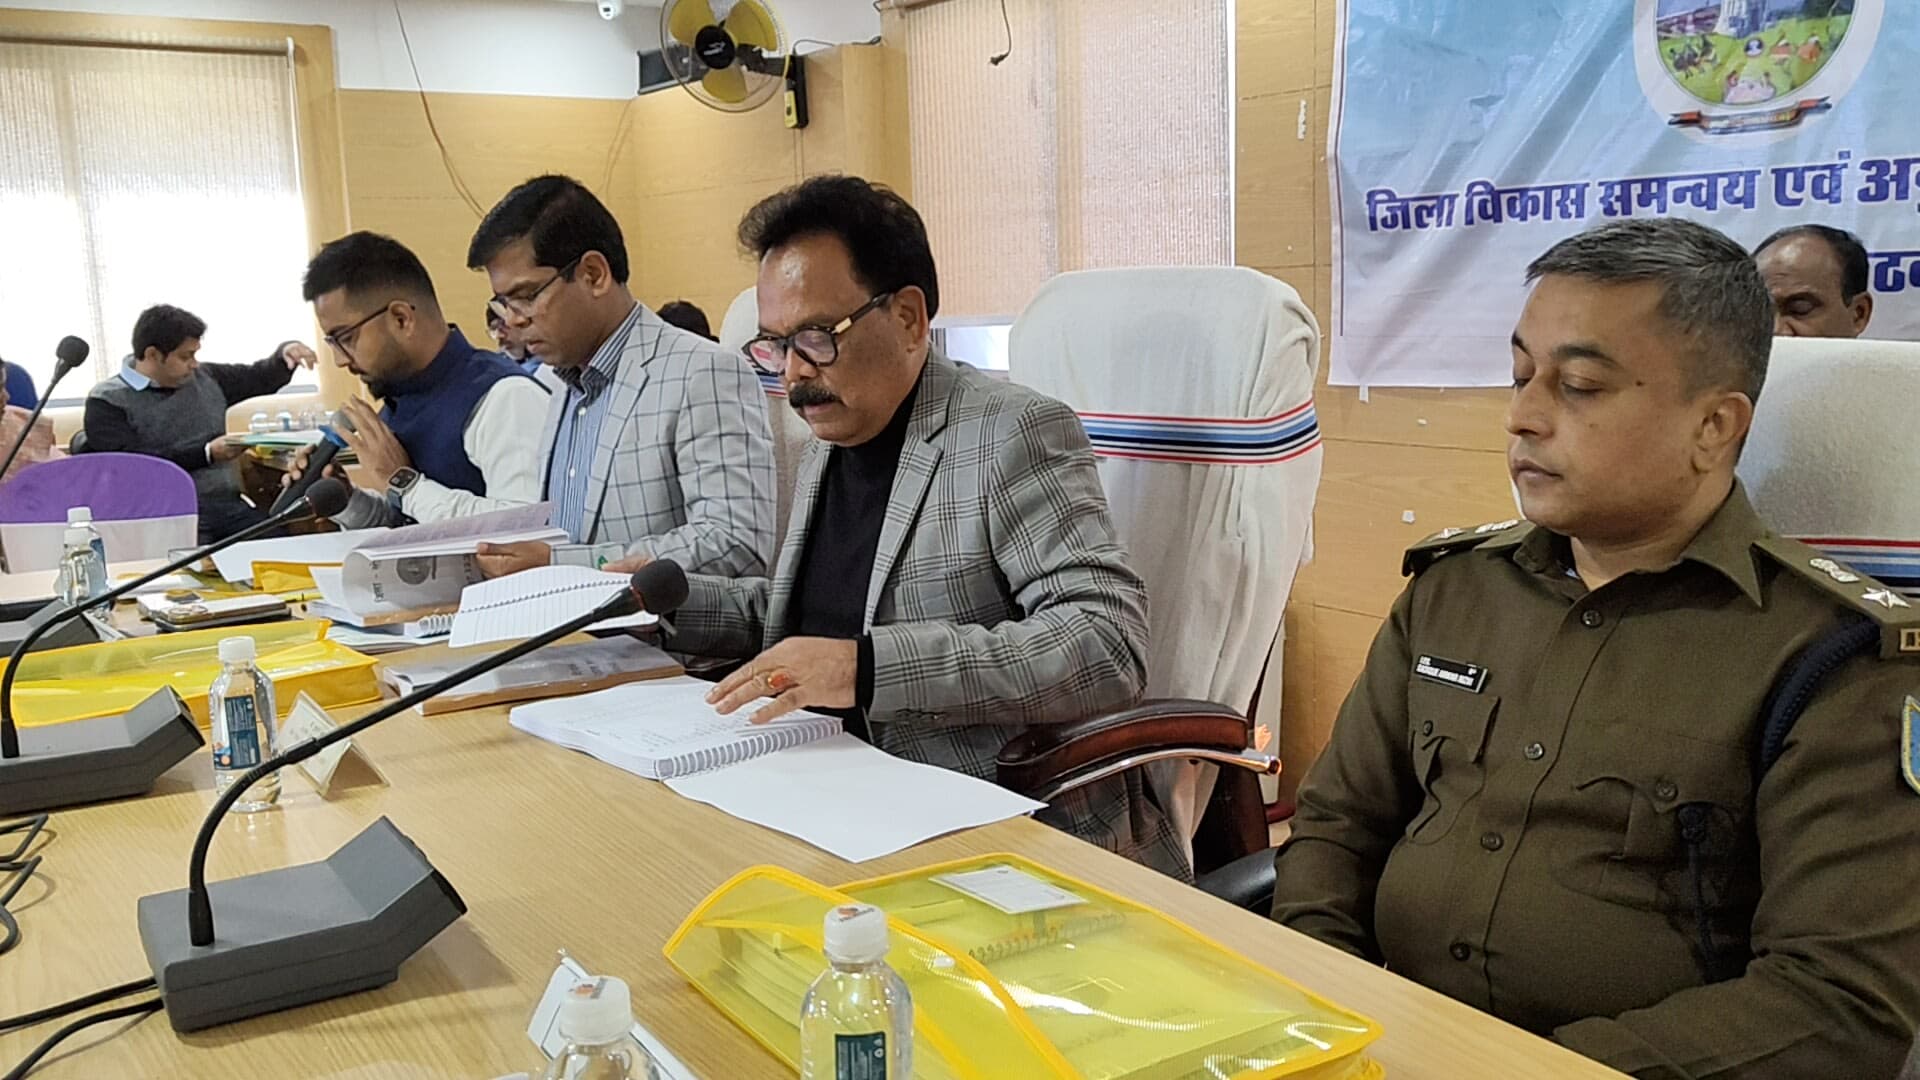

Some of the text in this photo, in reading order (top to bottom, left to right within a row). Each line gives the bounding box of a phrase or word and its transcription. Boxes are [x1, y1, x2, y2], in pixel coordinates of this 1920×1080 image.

[1366, 189, 1459, 231] जिला
[1464, 180, 1590, 226] विकास
[1598, 169, 1761, 217] समन्वय
[1771, 150, 1851, 206] एवं
